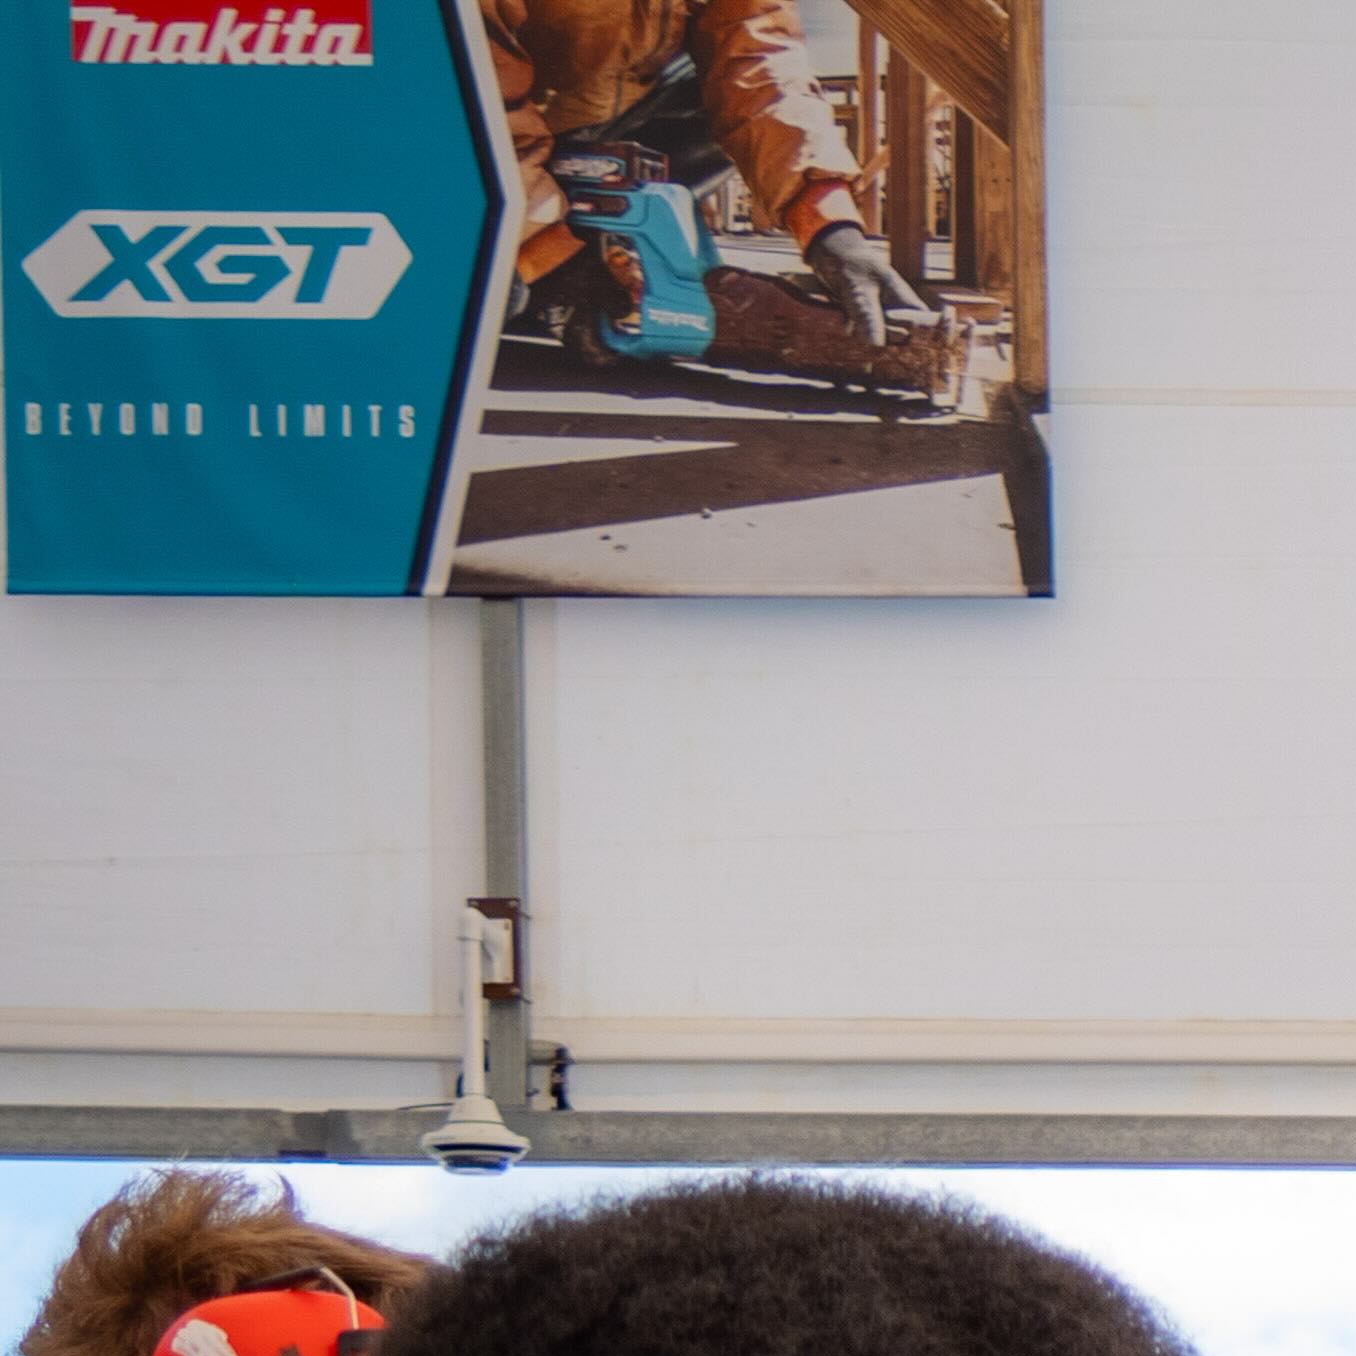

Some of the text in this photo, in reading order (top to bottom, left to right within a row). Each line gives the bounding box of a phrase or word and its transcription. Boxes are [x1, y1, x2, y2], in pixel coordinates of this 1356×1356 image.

[68, 223, 374, 304] XGT
[25, 402, 415, 438] BEYOND LIMITS
